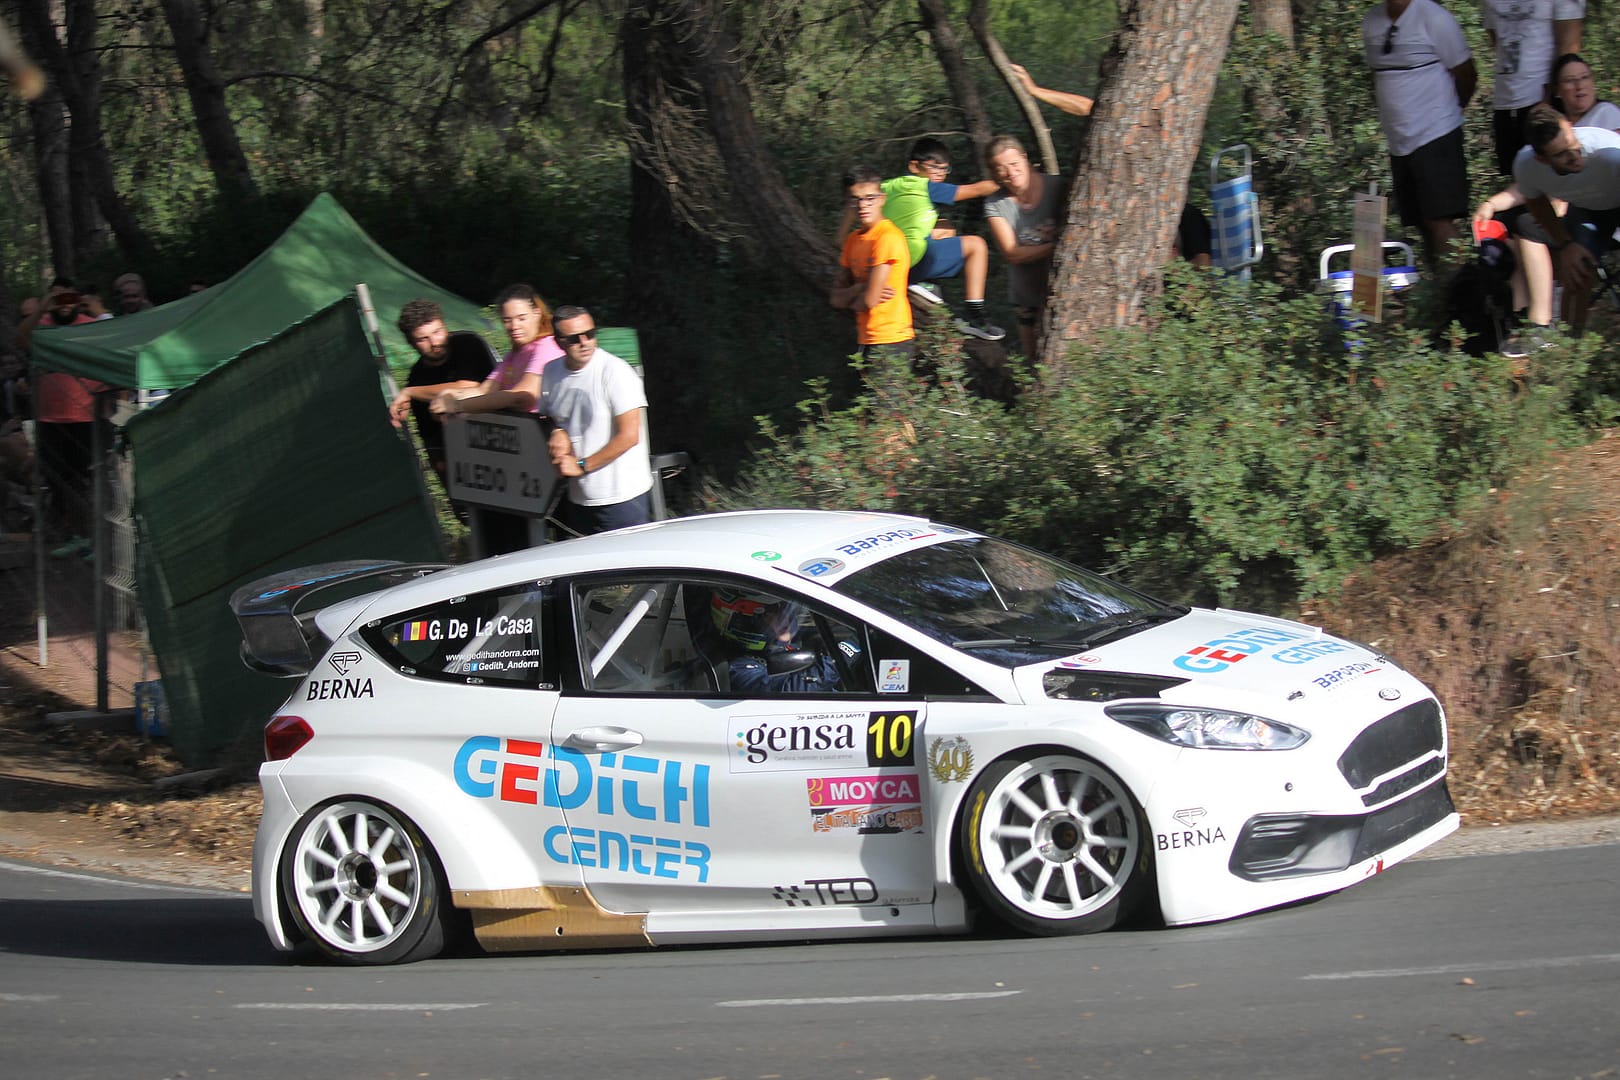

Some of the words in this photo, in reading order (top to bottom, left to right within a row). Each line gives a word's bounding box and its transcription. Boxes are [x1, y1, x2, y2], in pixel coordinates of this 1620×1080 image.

[429, 620, 444, 640] G.
[448, 619, 469, 639] De
[475, 617, 493, 637] La
[497, 615, 533, 636] Casa
[445, 648, 540, 662] www.gedithandorra.com
[478, 660, 539, 671] Gedith_Andorra
[307, 678, 374, 700] BERNA
[746, 723, 855, 764] gensa
[868, 715, 912, 759] 10
[936, 747, 969, 776] 40
[830, 780, 914, 800] MOYCA
[1157, 826, 1226, 851] BERNA
[804, 877, 879, 905] TED
